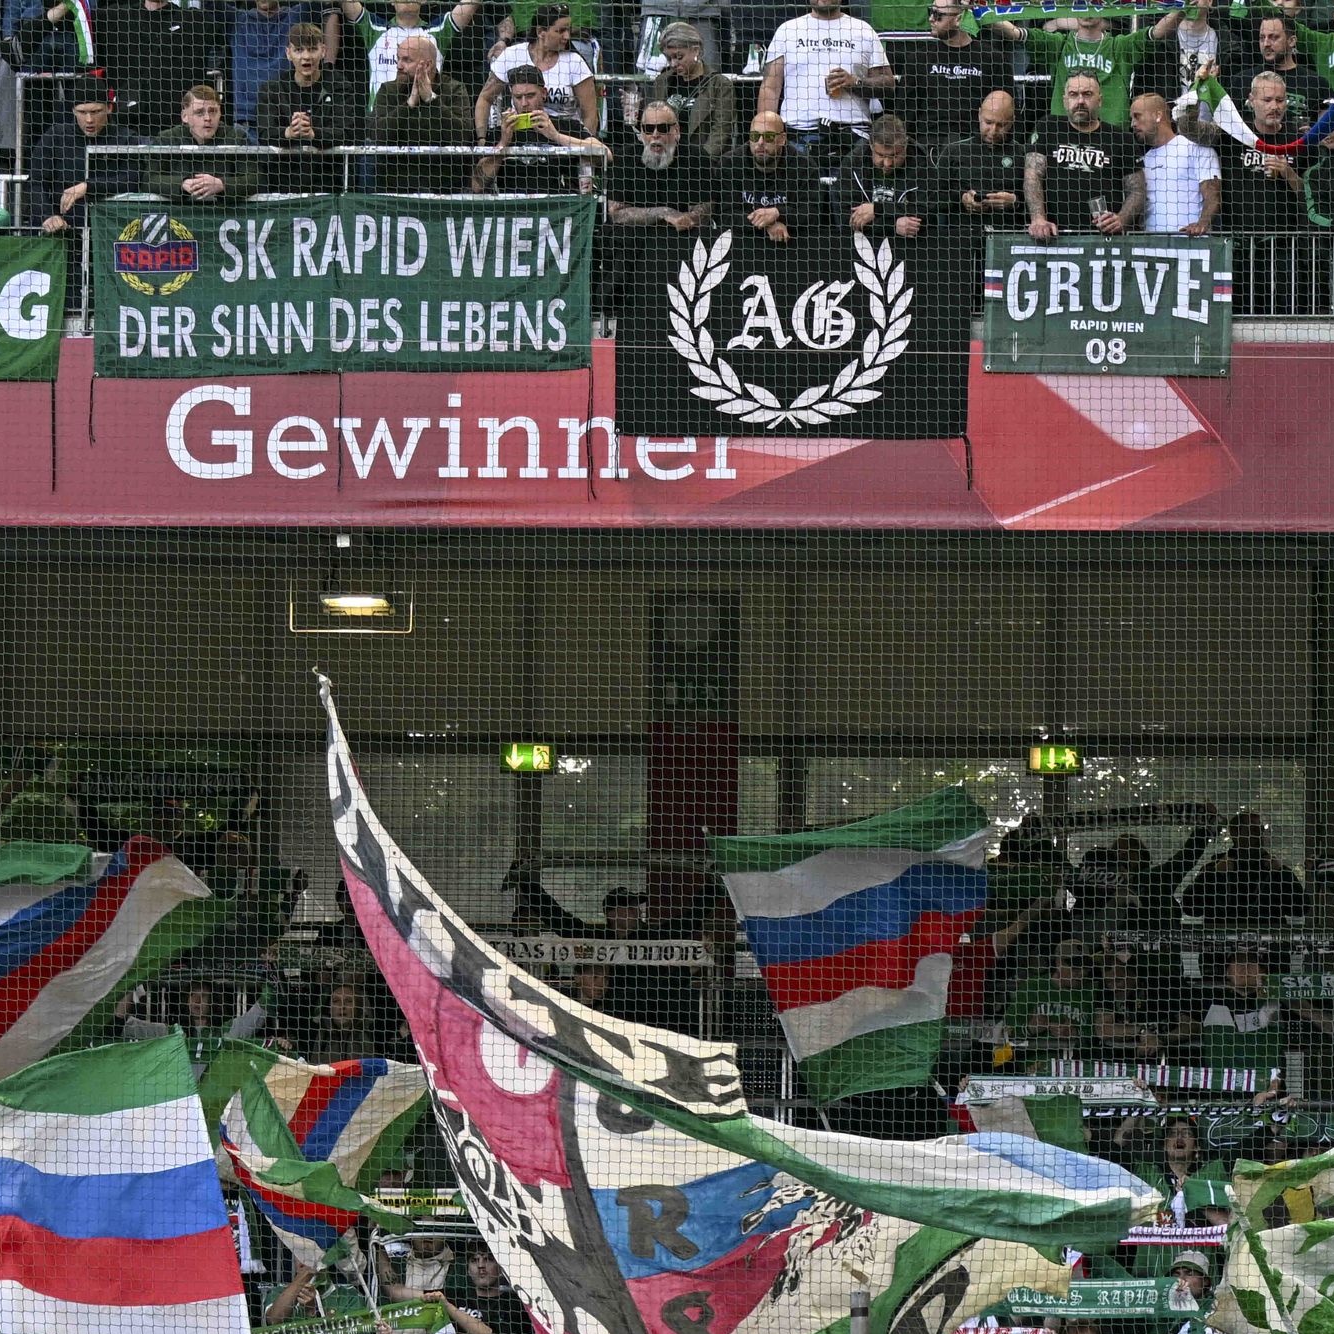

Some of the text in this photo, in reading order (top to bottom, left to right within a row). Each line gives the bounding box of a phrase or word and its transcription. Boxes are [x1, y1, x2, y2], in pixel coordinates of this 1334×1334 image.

[1056, 144, 1105, 168] GRÜVE
[119, 216, 572, 282] RAPID SK RAPID WIEN
[1006, 245, 1211, 323] GRÜVE
[119, 297, 567, 358] DER SINN DES LEBENS
[1070, 319, 1144, 333] RAPID WIEN
[1085, 338, 1127, 365] 08
[166, 384, 737, 480] Gewinner
[1282, 975, 1314, 989] SK
